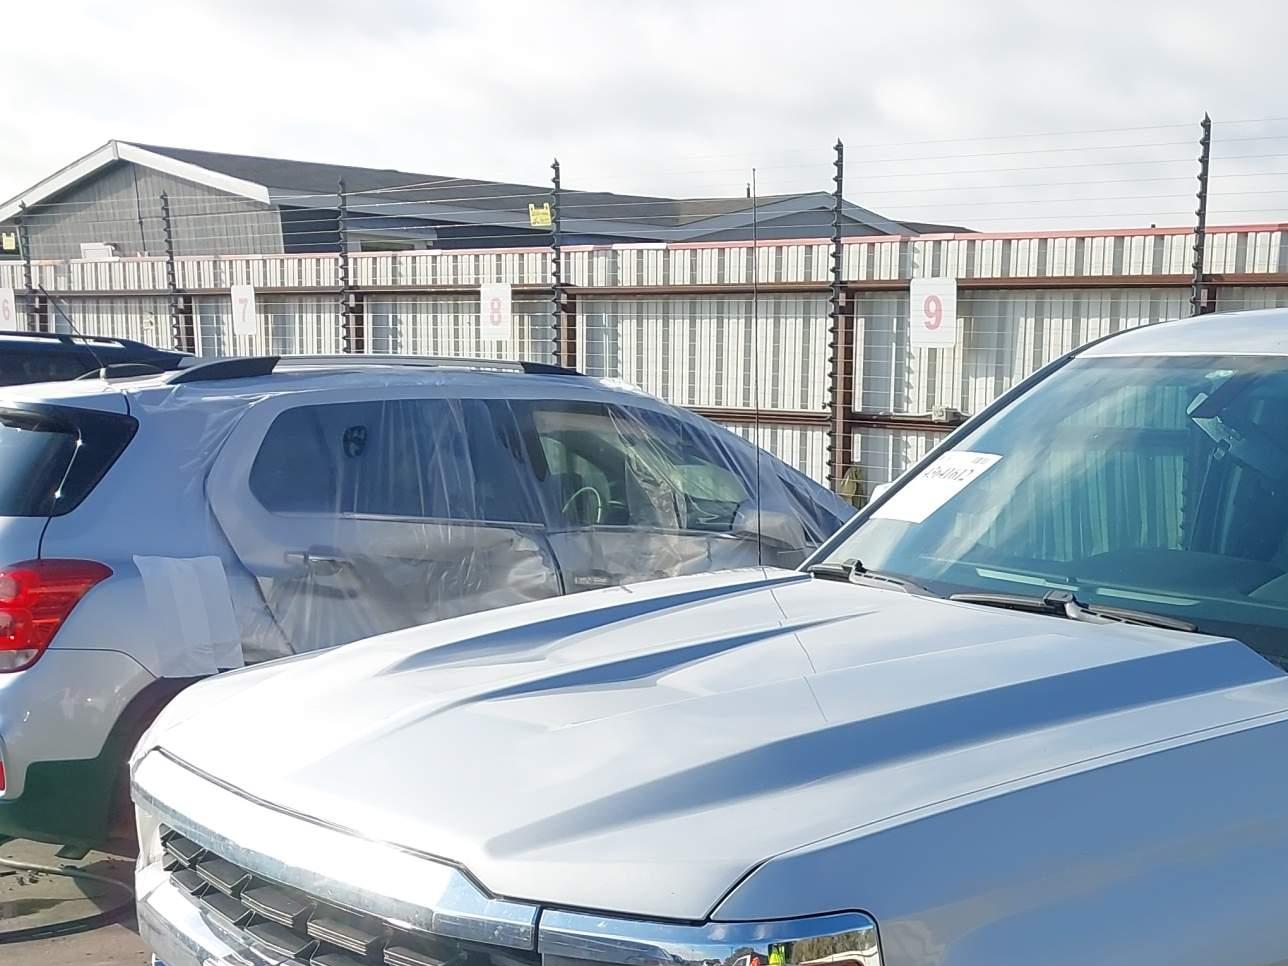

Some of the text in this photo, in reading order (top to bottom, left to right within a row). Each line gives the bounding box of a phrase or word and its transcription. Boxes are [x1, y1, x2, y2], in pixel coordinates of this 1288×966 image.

[2, 298, 10, 321] 6
[238, 298, 248, 322] 7
[490, 298, 502, 326] 8
[924, 295, 942, 330] 9
